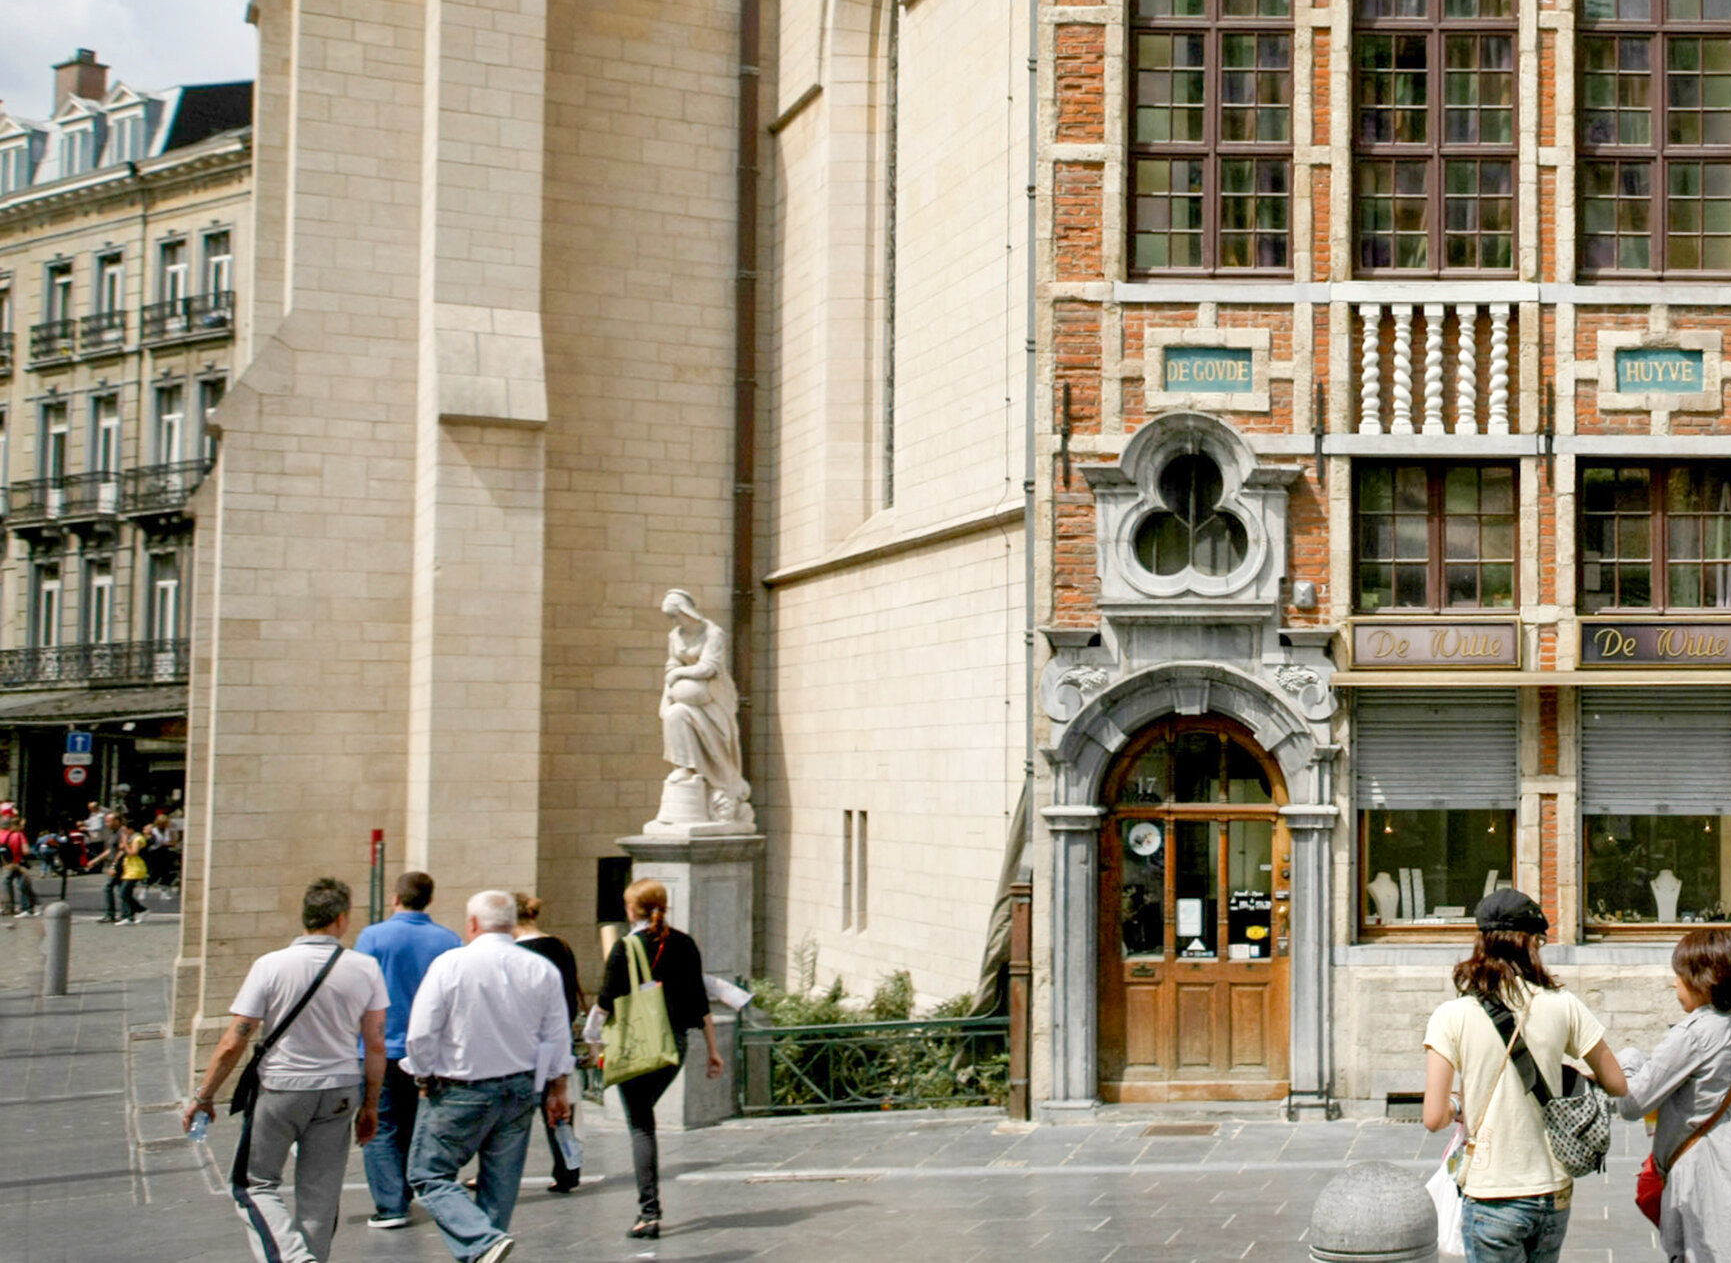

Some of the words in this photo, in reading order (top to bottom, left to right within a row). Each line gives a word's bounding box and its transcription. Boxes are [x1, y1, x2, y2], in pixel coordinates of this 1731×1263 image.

[1167, 360, 1190, 382] DE
[1625, 360, 1696, 383] HUYVE
[1367, 629, 1411, 658] De
[1594, 627, 1637, 657] De
[1137, 777, 1157, 794] 17
